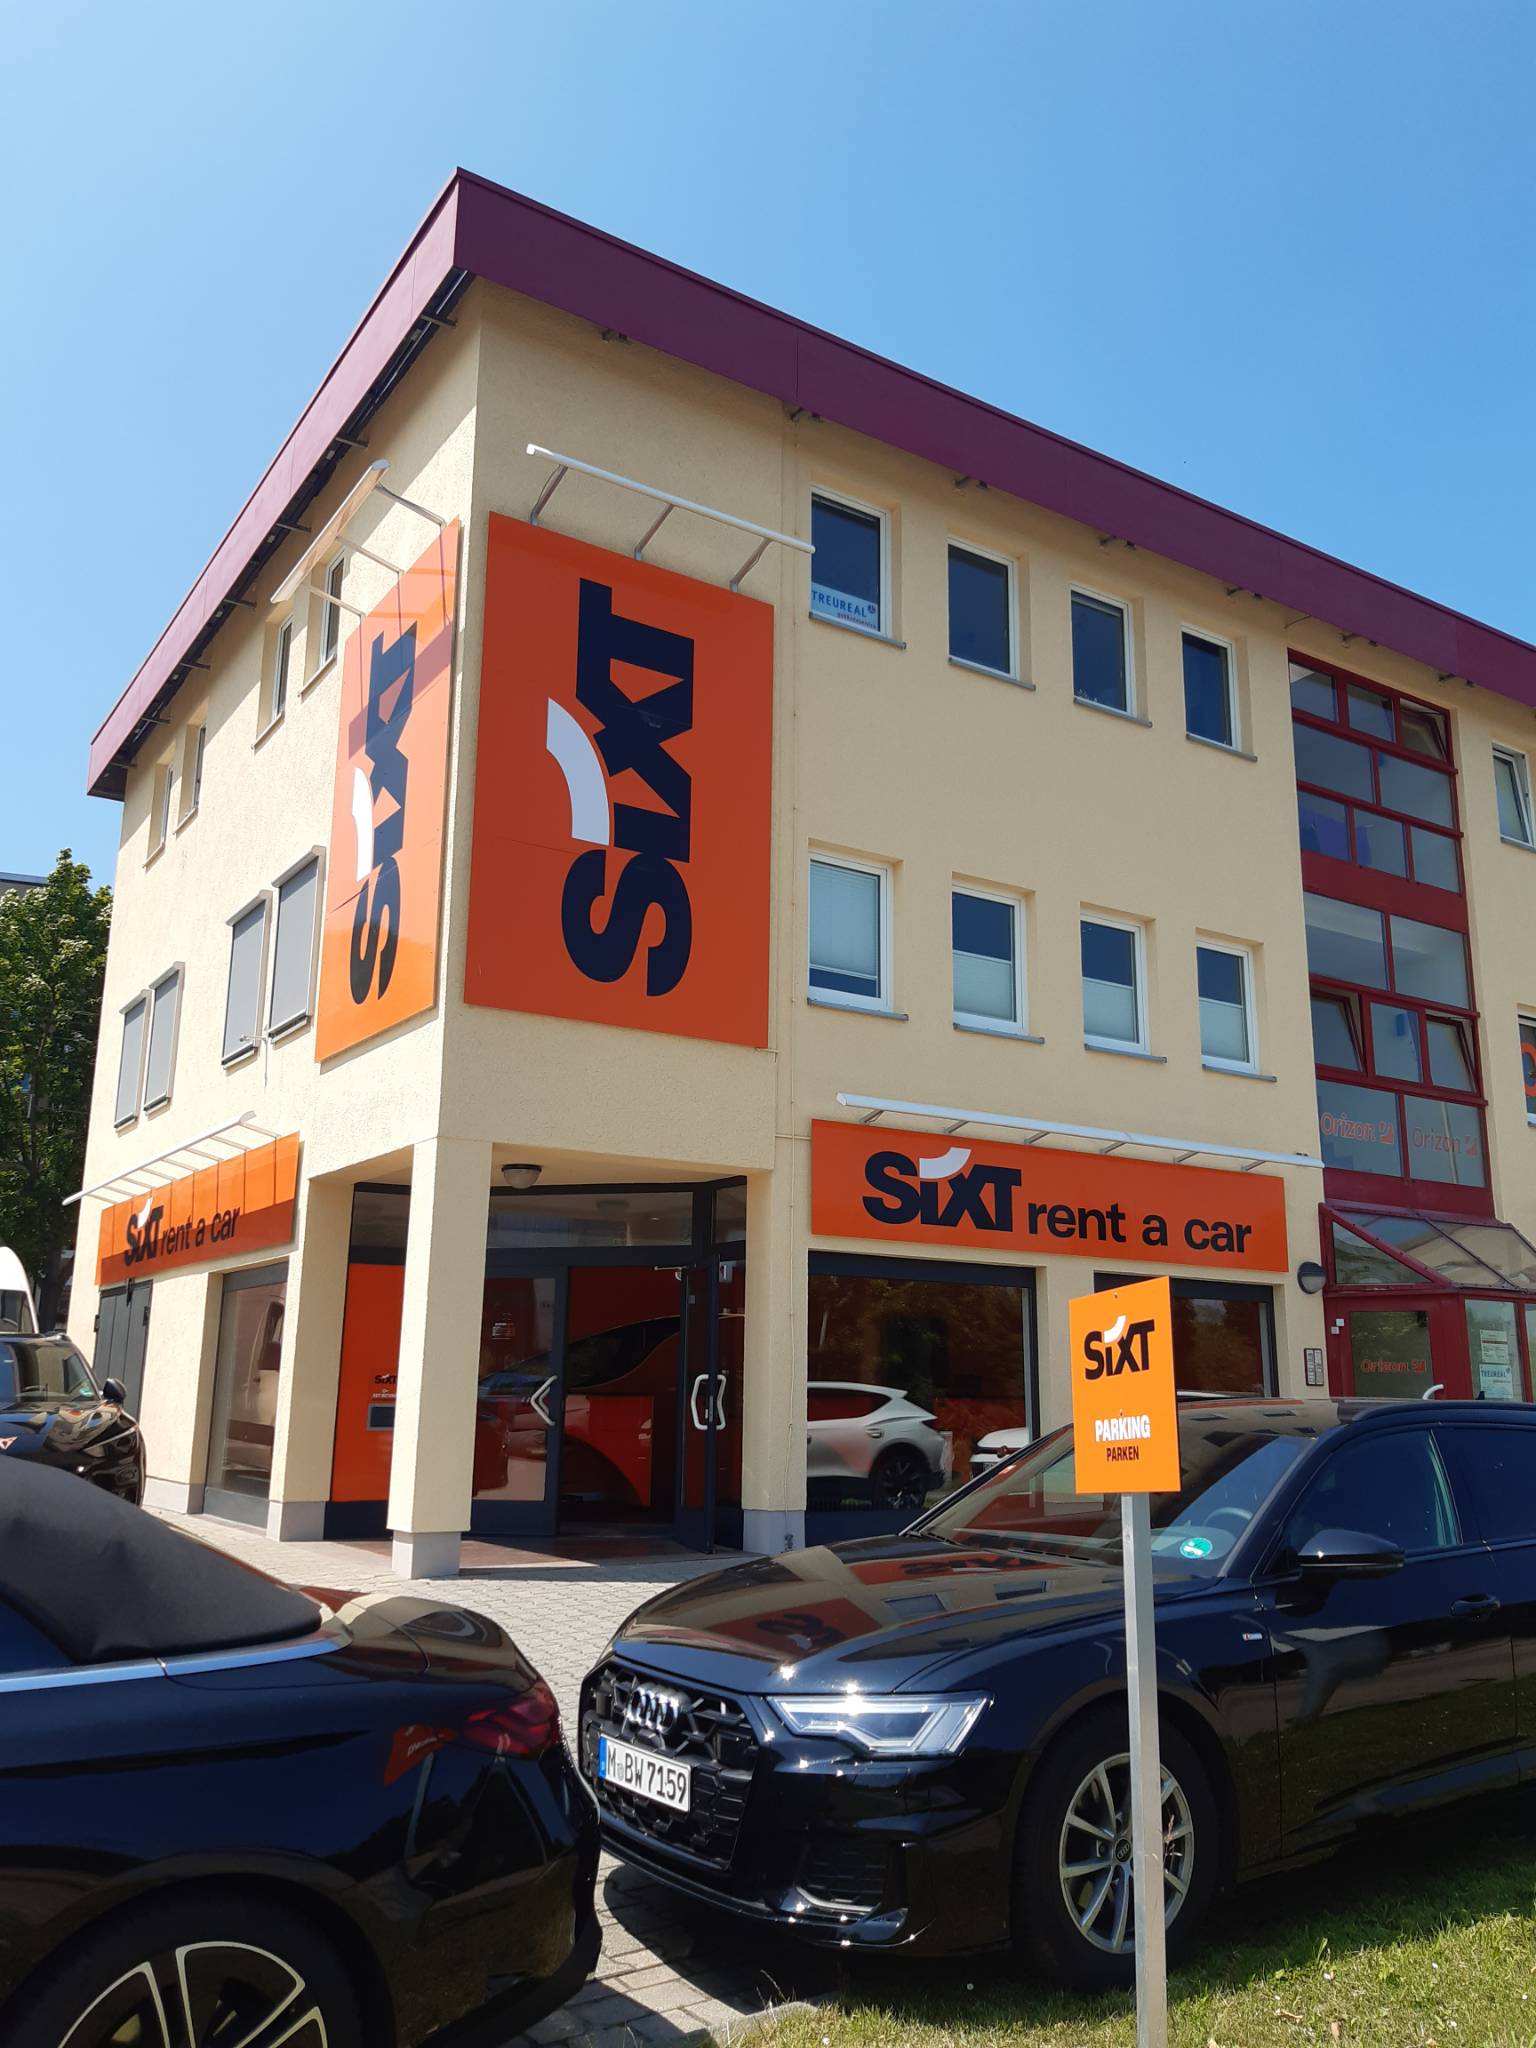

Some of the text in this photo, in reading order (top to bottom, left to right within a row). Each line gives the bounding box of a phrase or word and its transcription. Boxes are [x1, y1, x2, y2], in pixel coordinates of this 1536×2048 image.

[812, 590, 867, 618] TREUREAL
[1320, 1111, 1377, 1143] Orizon
[1412, 1126, 1461, 1153] Orizon
[160, 1215, 193, 1257] rent
[195, 1217, 206, 1248] a
[210, 1207, 241, 1243] car
[1028, 1201, 1126, 1243] rent
[1142, 1213, 1168, 1247] a
[1184, 1218, 1252, 1254] car
[1095, 1414, 1151, 1442] PARKING
[1106, 1445, 1139, 1462] PARKEN
